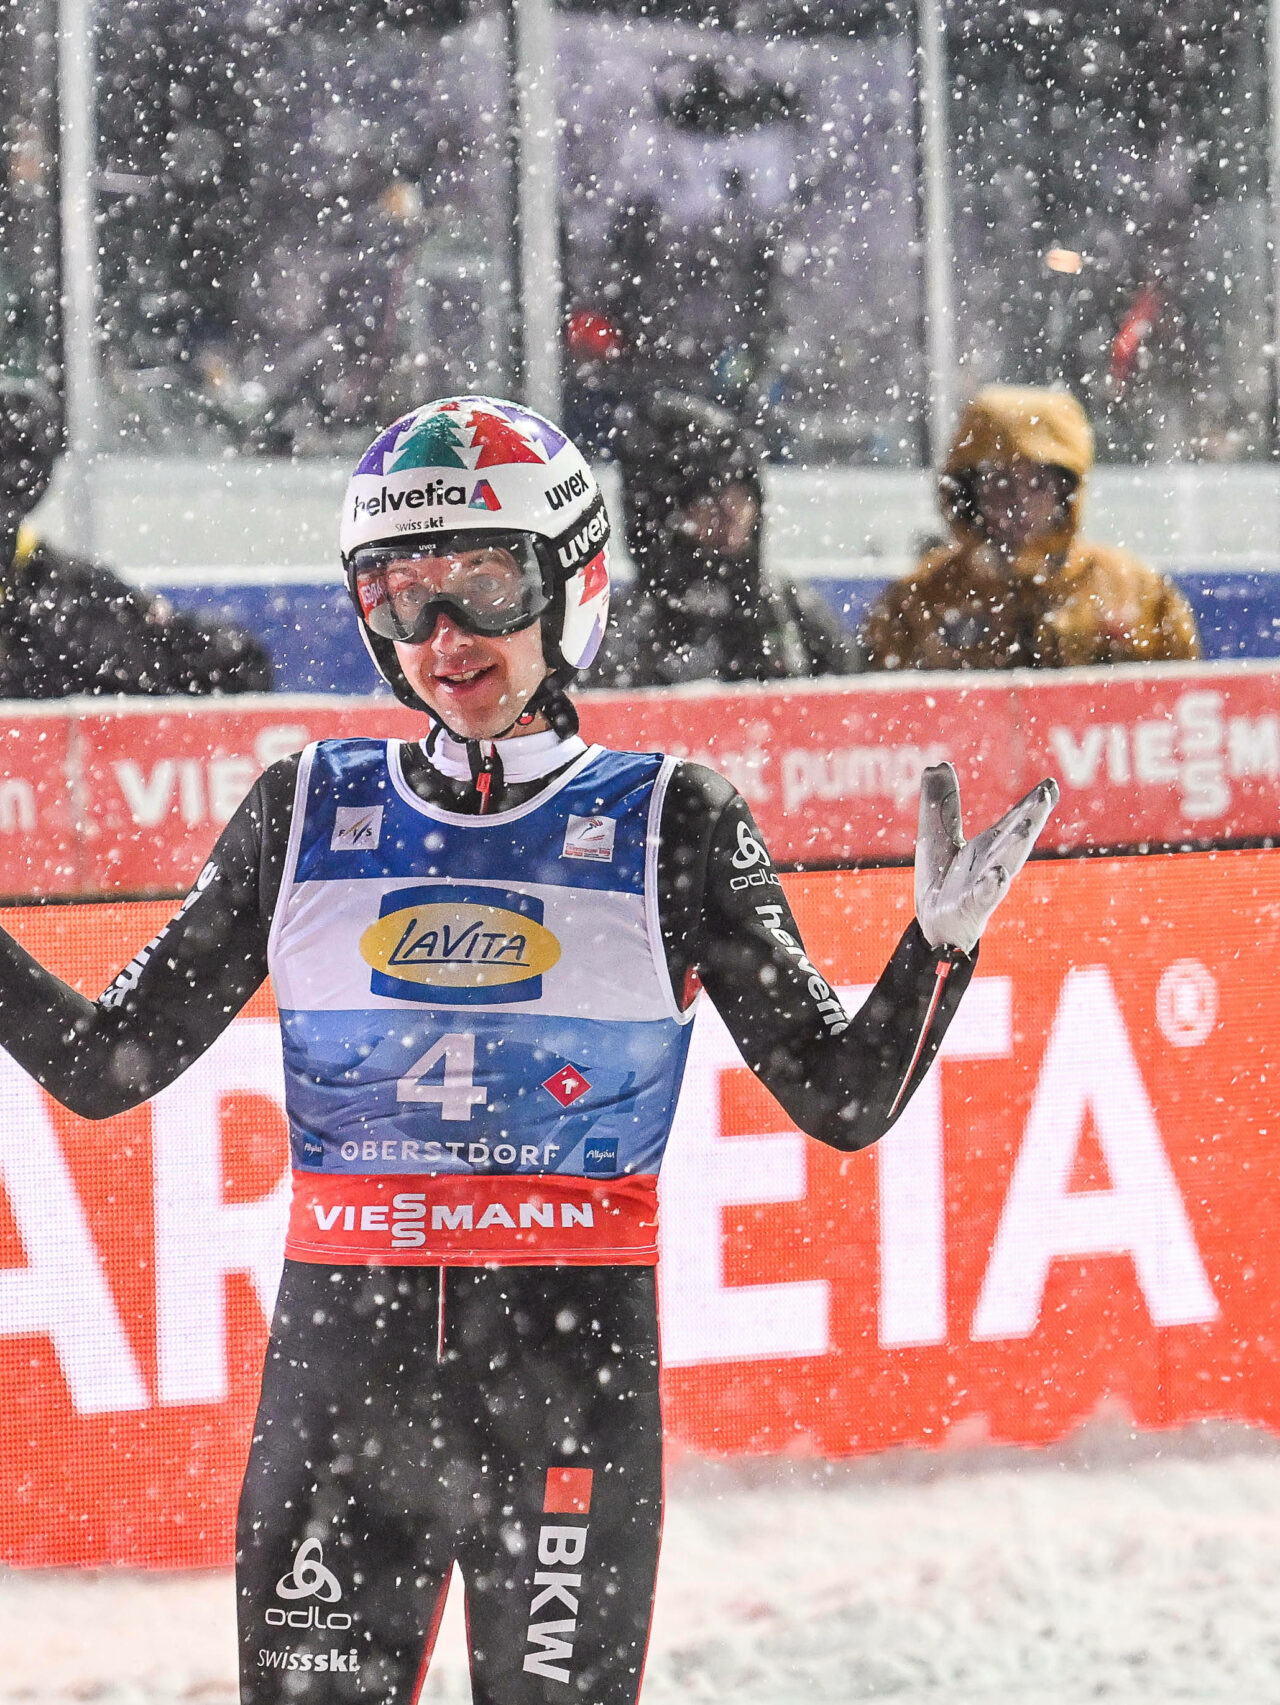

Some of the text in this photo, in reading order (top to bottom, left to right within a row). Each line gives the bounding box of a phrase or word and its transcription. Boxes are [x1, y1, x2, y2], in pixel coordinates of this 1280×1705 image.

[354, 479, 466, 522] helvetia
[545, 469, 589, 511] uvex
[558, 506, 609, 568] uvex
[396, 1033, 487, 1121] 4
[340, 1139, 561, 1166] OBERSTDORF
[313, 1193, 594, 1248] VIESSMANN
[264, 1605, 352, 1631] odlo
[523, 1525, 589, 1684] BKW
[257, 1645, 361, 1673] swissski
